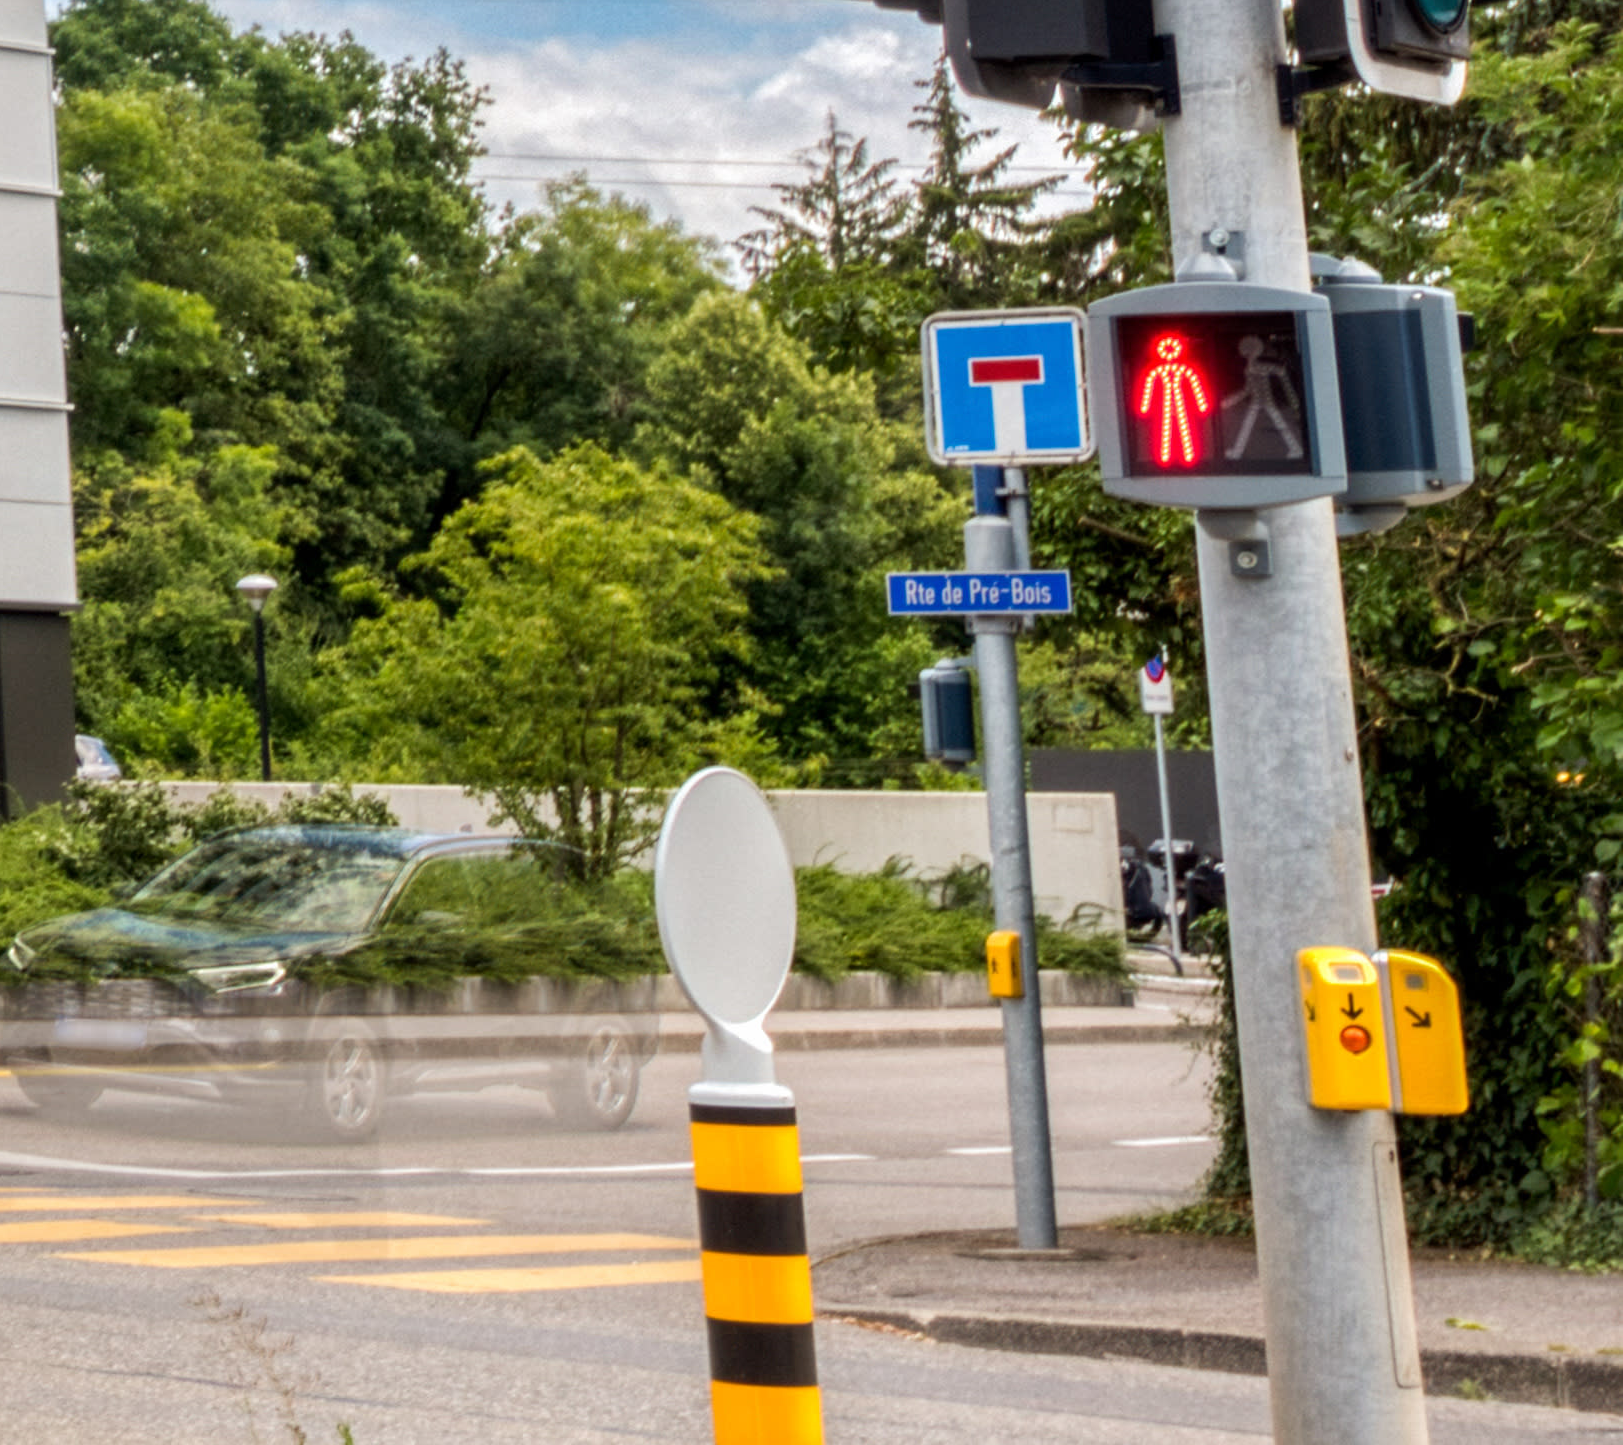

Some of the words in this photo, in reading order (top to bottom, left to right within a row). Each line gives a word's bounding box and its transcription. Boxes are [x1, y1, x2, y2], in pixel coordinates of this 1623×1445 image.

[905, 579, 935, 605] Rte
[942, 577, 963, 605] de
[969, 577, 1052, 605] Pré-Bois
